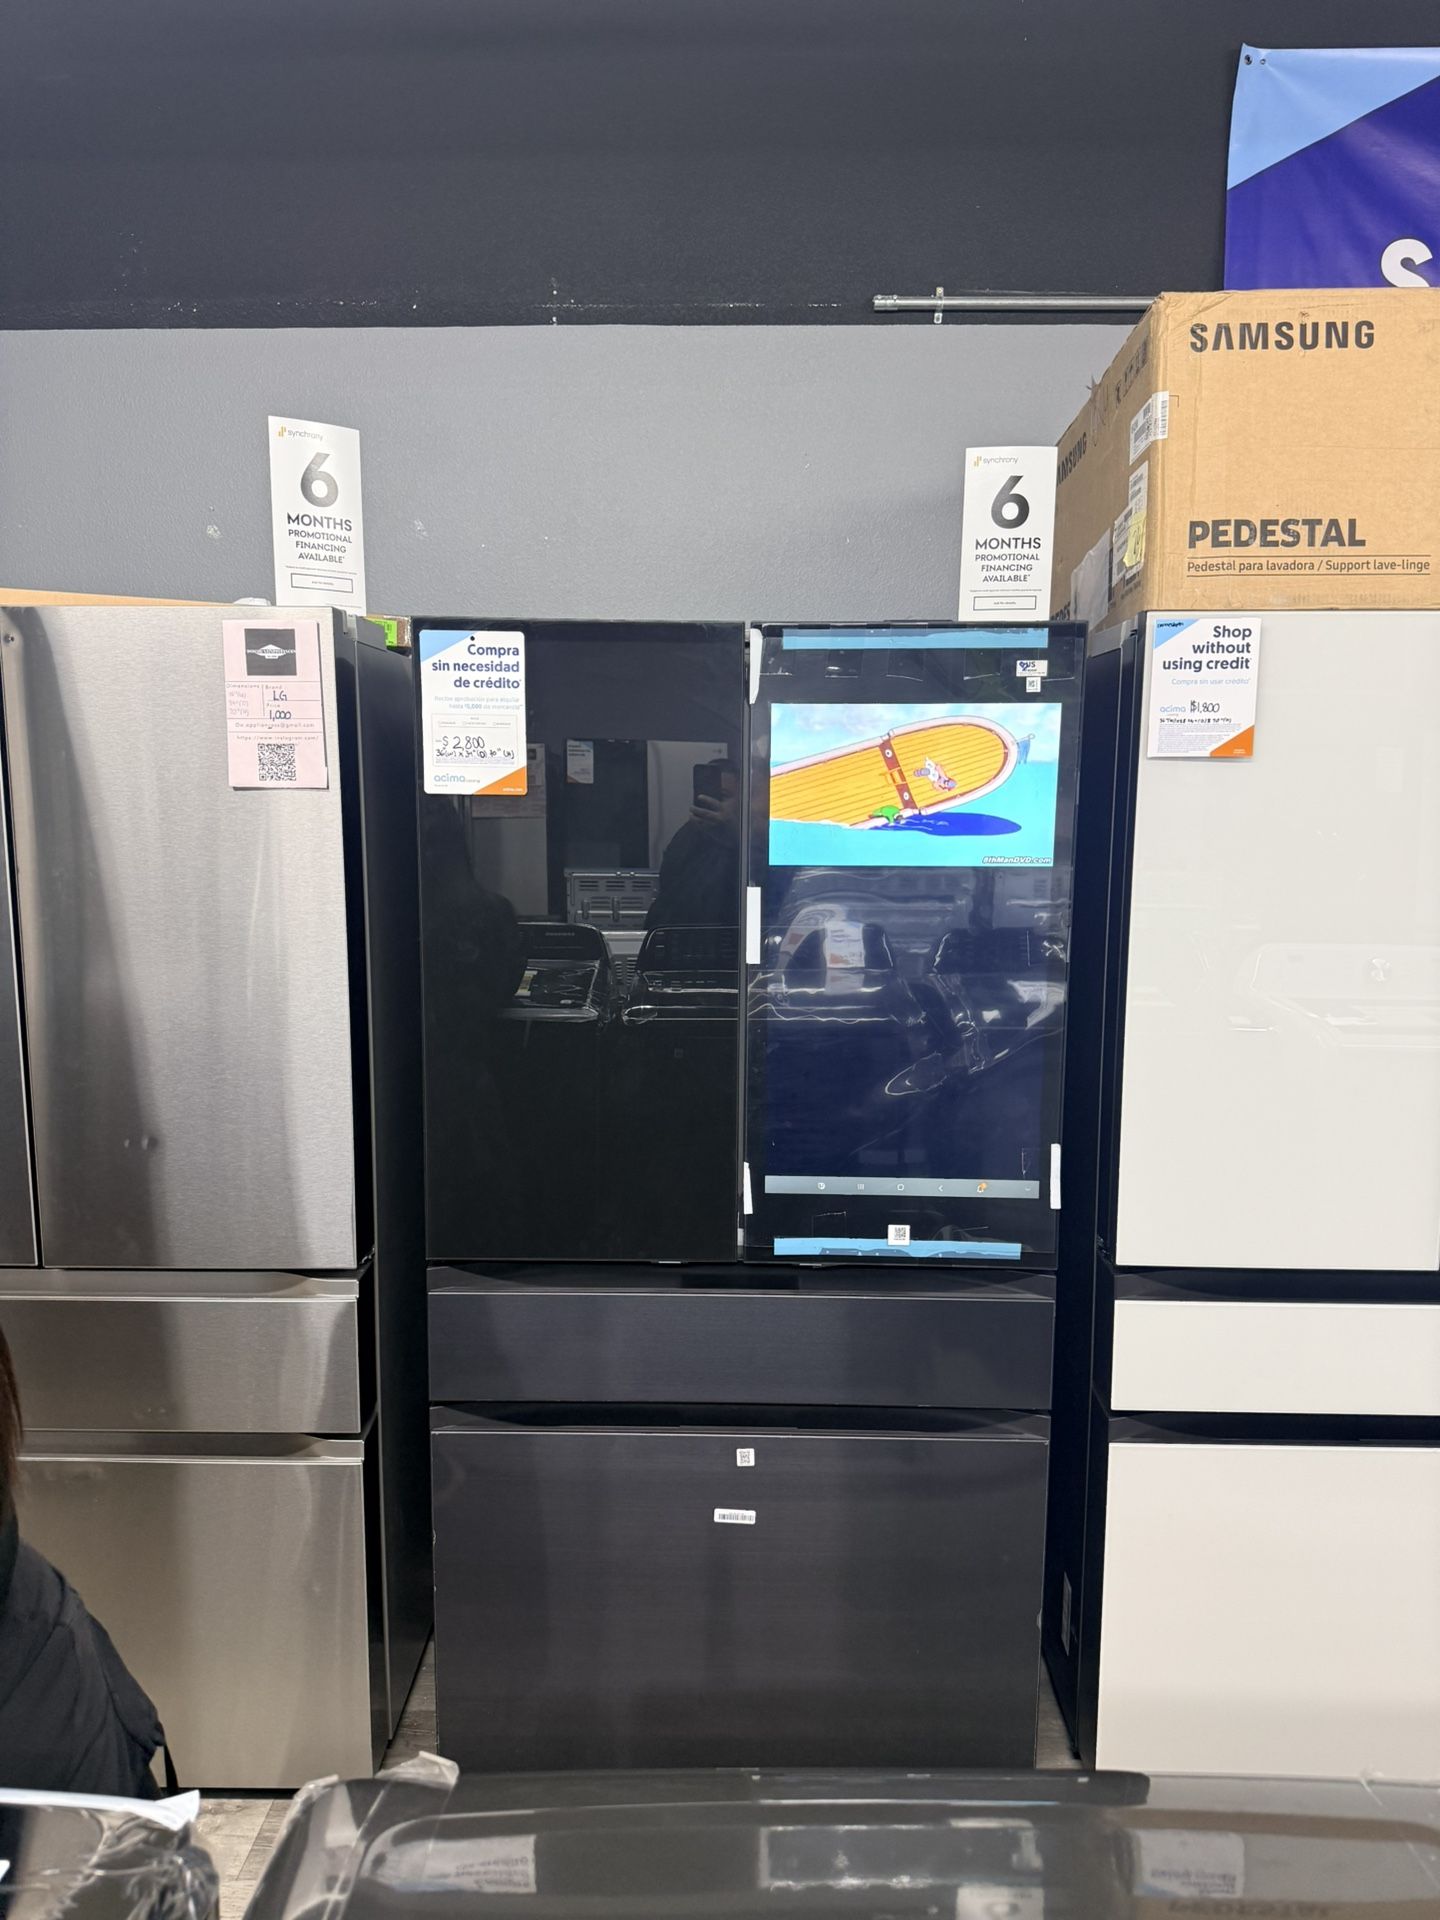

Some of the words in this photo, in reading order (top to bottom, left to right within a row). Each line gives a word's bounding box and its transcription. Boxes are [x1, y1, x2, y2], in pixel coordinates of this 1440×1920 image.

[1189, 319, 1375, 353] SAMSUNG
[287, 429, 323, 441] synchrony
[982, 455, 1018, 464] synchrony
[1056, 432, 1087, 487] AMSUNG
[300, 452, 339, 508] 6
[991, 475, 1030, 529] 6
[287, 512, 353, 532] MONTHS
[288, 530, 353, 544] PROMOTIONAL
[1188, 518, 1366, 549] PEDESTAL
[295, 541, 347, 554] FINANCING
[975, 537, 1041, 551] MONTHS
[975, 553, 1040, 561] PROMOTIONAL
[981, 564, 1033, 572] FINANCING
[1187, 560, 1236, 573] Pedestal
[1239, 562, 1263, 574] para
[1265, 559, 1315, 572] lavadora
[1325, 559, 1370, 574] Support
[1373, 558, 1430, 573] lave-linge
[1213, 625, 1252, 641] Shop
[467, 644, 520, 659] Compra
[1192, 641, 1251, 654] without
[432, 660, 450, 671] sin
[453, 660, 520, 672] necesidad
[1162, 656, 1202, 673] using
[454, 676, 471, 688] de
[1171, 678, 1198, 686] Compra
[273, 690, 288, 701] LG
[269, 709, 292, 722] 1,000
[1159, 704, 1186, 714] acima
[452, 735, 486, 752] 2,800
[433, 773, 466, 783] acima
